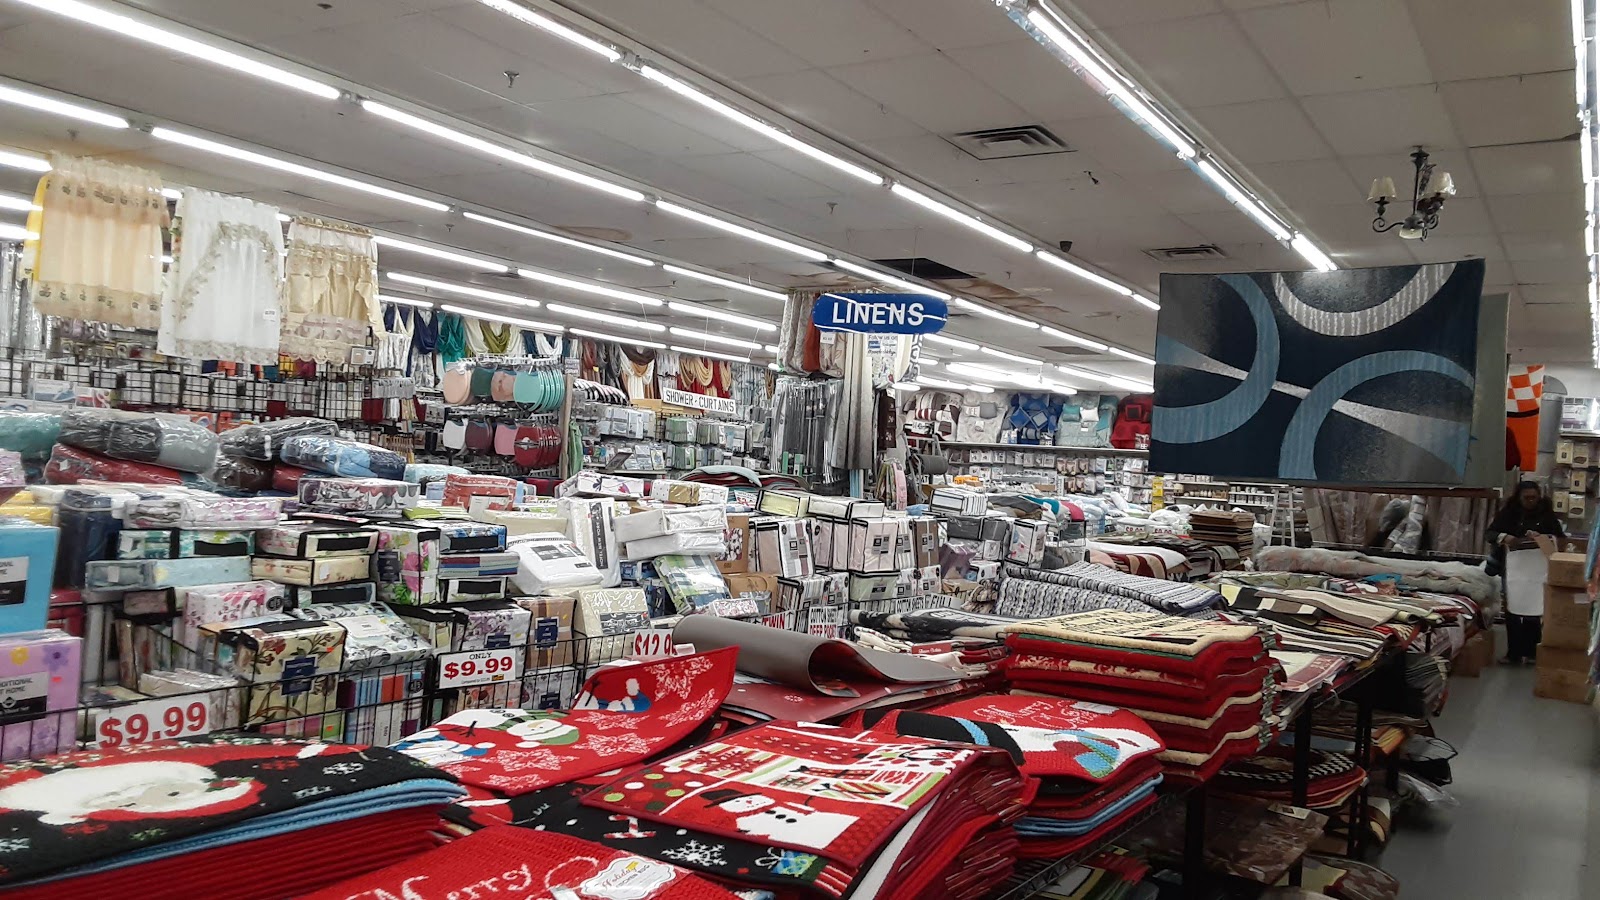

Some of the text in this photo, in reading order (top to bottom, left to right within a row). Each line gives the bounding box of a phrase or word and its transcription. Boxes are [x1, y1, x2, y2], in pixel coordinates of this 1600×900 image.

[832, 302, 925, 326] LINENS
[665, 390, 694, 406] SHOWER
[699, 396, 735, 413] CURTAINS
[444, 656, 513, 680] $9.99
[469, 652, 492, 660] ONLY
[99, 702, 207, 748] $9.99
